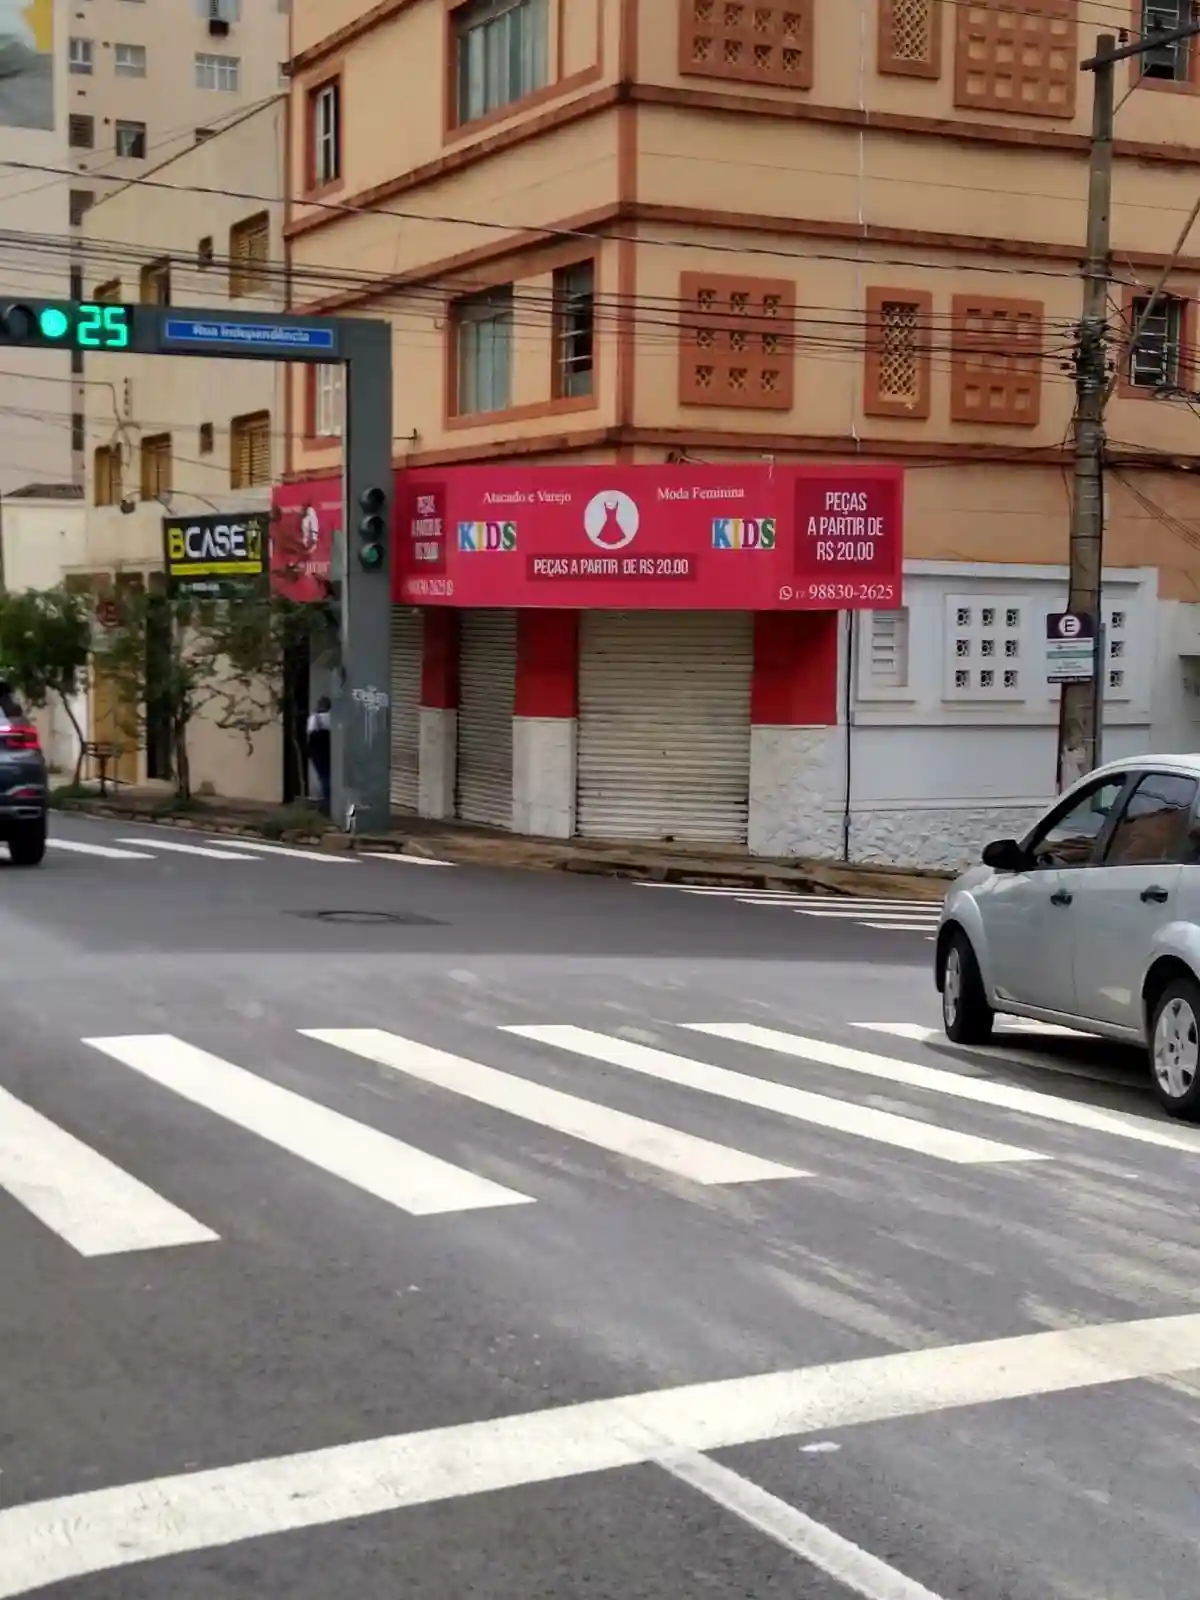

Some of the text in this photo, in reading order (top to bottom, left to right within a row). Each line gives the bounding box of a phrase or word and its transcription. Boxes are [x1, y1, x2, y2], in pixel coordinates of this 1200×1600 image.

[77, 305, 128, 347] 25
[192, 324, 218, 337] Rua
[483, 489, 571, 505] Atacado e Varejo
[657, 486, 745, 500] Moda Feminina
[825, 492, 868, 515] PEÇAS
[712, 518, 776, 549] KIDS
[807, 516, 884, 536] A PARTIR DE
[458, 521, 517, 551] KIDS
[816, 540, 874, 562] R$ 20,00
[534, 558, 569, 577] PEÇAS
[570, 559, 579, 575] A
[580, 559, 618, 575] PARTIR
[623, 559, 637, 575] DE
[808, 584, 893, 600] 98830-2625
[1064, 618, 1076, 633] E
